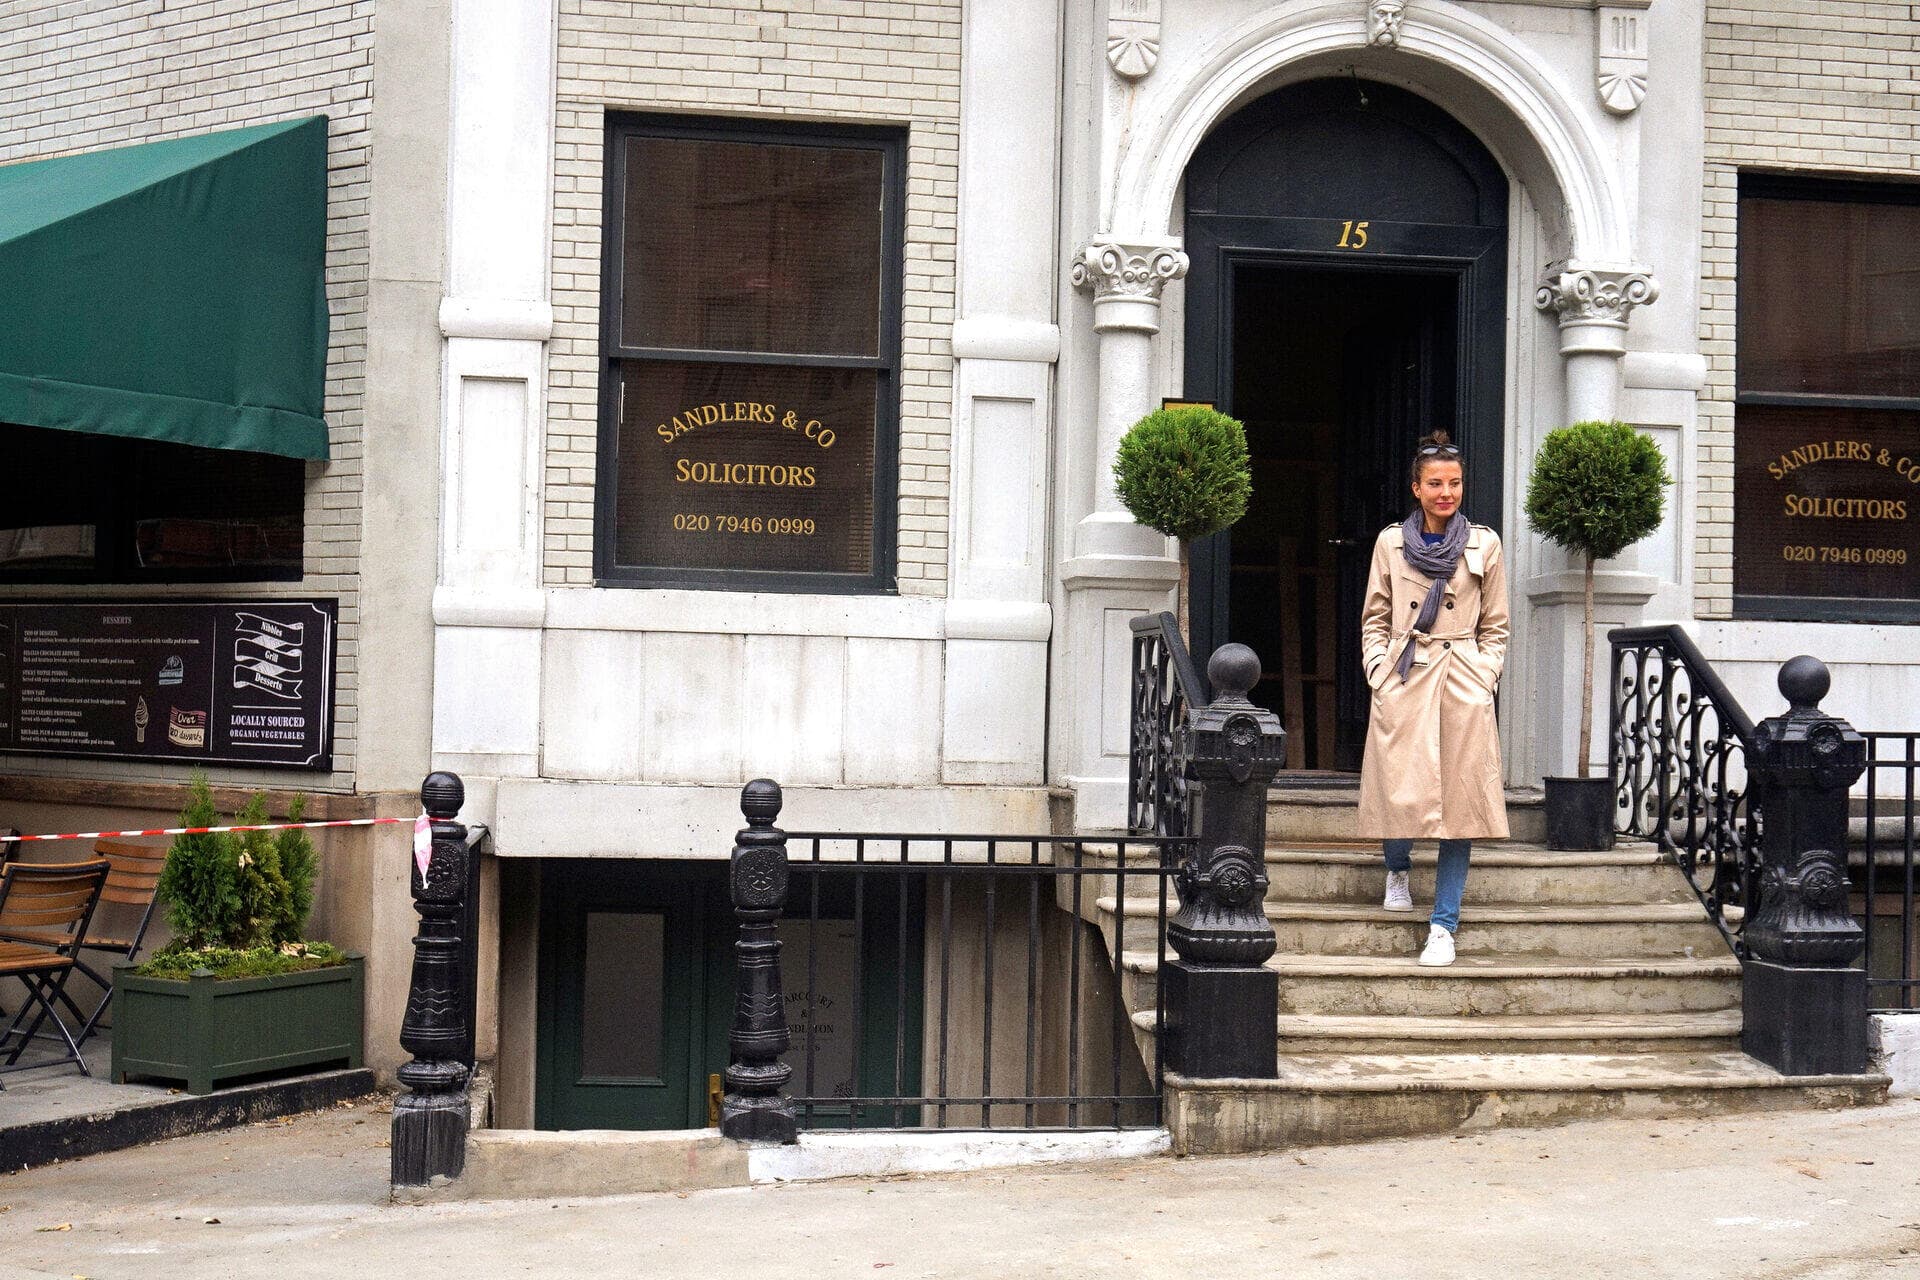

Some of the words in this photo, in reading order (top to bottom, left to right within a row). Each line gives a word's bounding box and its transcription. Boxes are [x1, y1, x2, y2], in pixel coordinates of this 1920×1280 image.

[1336, 220, 1369, 249] 15
[657, 402, 776, 443] SANDLERS
[782, 410, 799, 430] &
[804, 419, 837, 448] CO
[676, 458, 816, 487] SOLICITORS
[1768, 441, 1872, 480] SANDLERS
[1876, 448, 1891, 467] &
[1896, 457, 1920, 484] CO
[1784, 494, 1908, 520] SOLICITORS
[673, 514, 711, 531] 020
[715, 515, 763, 534] 7946
[767, 517, 816, 535] 0999
[1783, 546, 1816, 561] 020
[1820, 547, 1862, 563] 7946
[1865, 549, 1908, 565] 0999
[261, 621, 283, 637] Nibbles
[265, 650, 280, 663] Grill
[255, 672, 284, 691] Desserts
[230, 714, 266, 726] LOCALLY
[267, 715, 305, 728] SOURCED
[229, 728, 260, 739] ORGANIC
[260, 730, 305, 740] VEGETABLES
